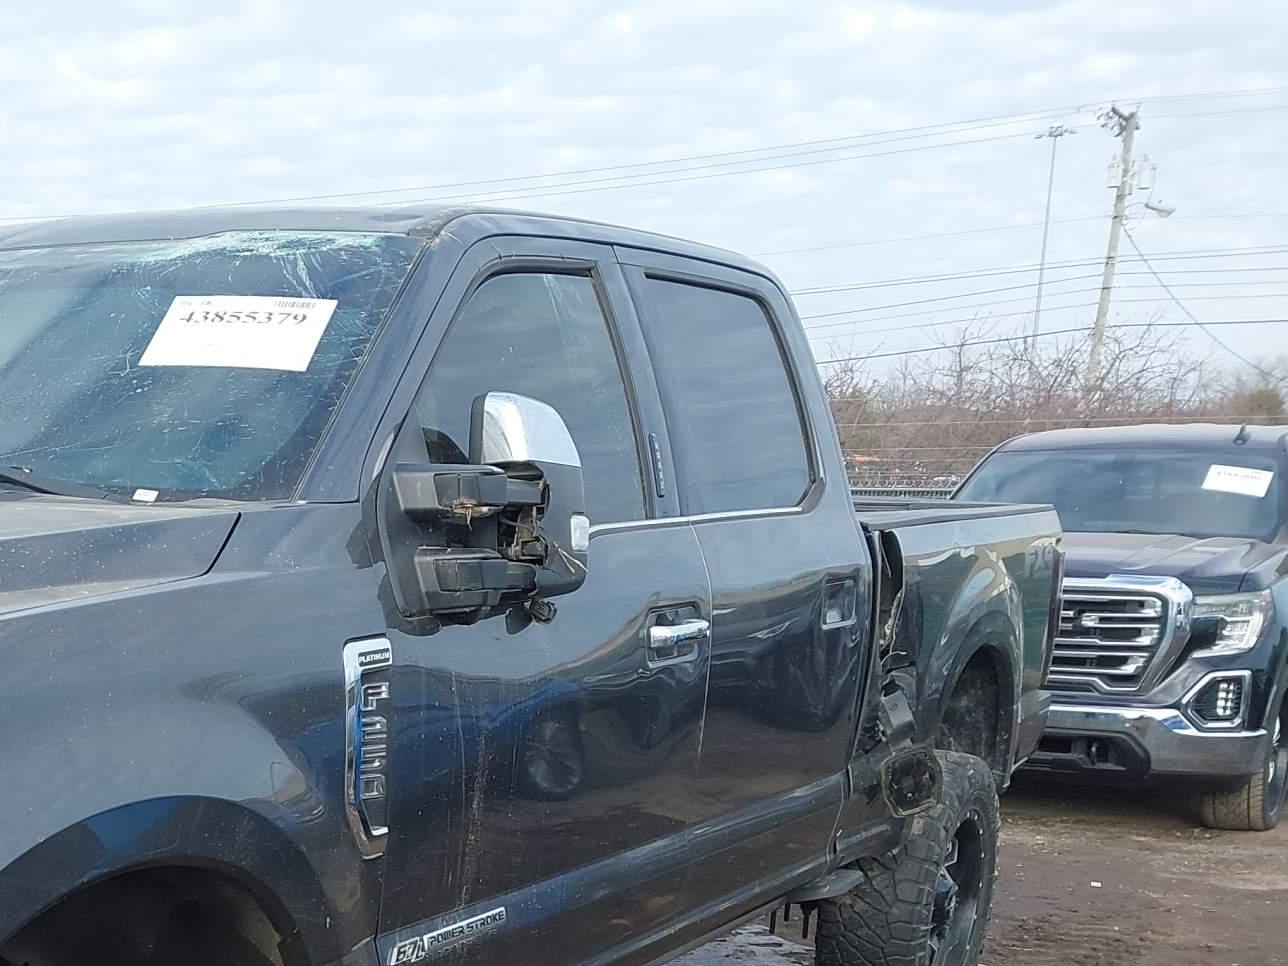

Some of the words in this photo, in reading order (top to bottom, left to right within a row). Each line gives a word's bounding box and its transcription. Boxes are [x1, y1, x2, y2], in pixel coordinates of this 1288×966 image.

[179, 310, 308, 325] 43855379
[358, 651, 390, 663] PLATINUM
[428, 926, 465, 946] POWER
[466, 910, 505, 933] STROKE
